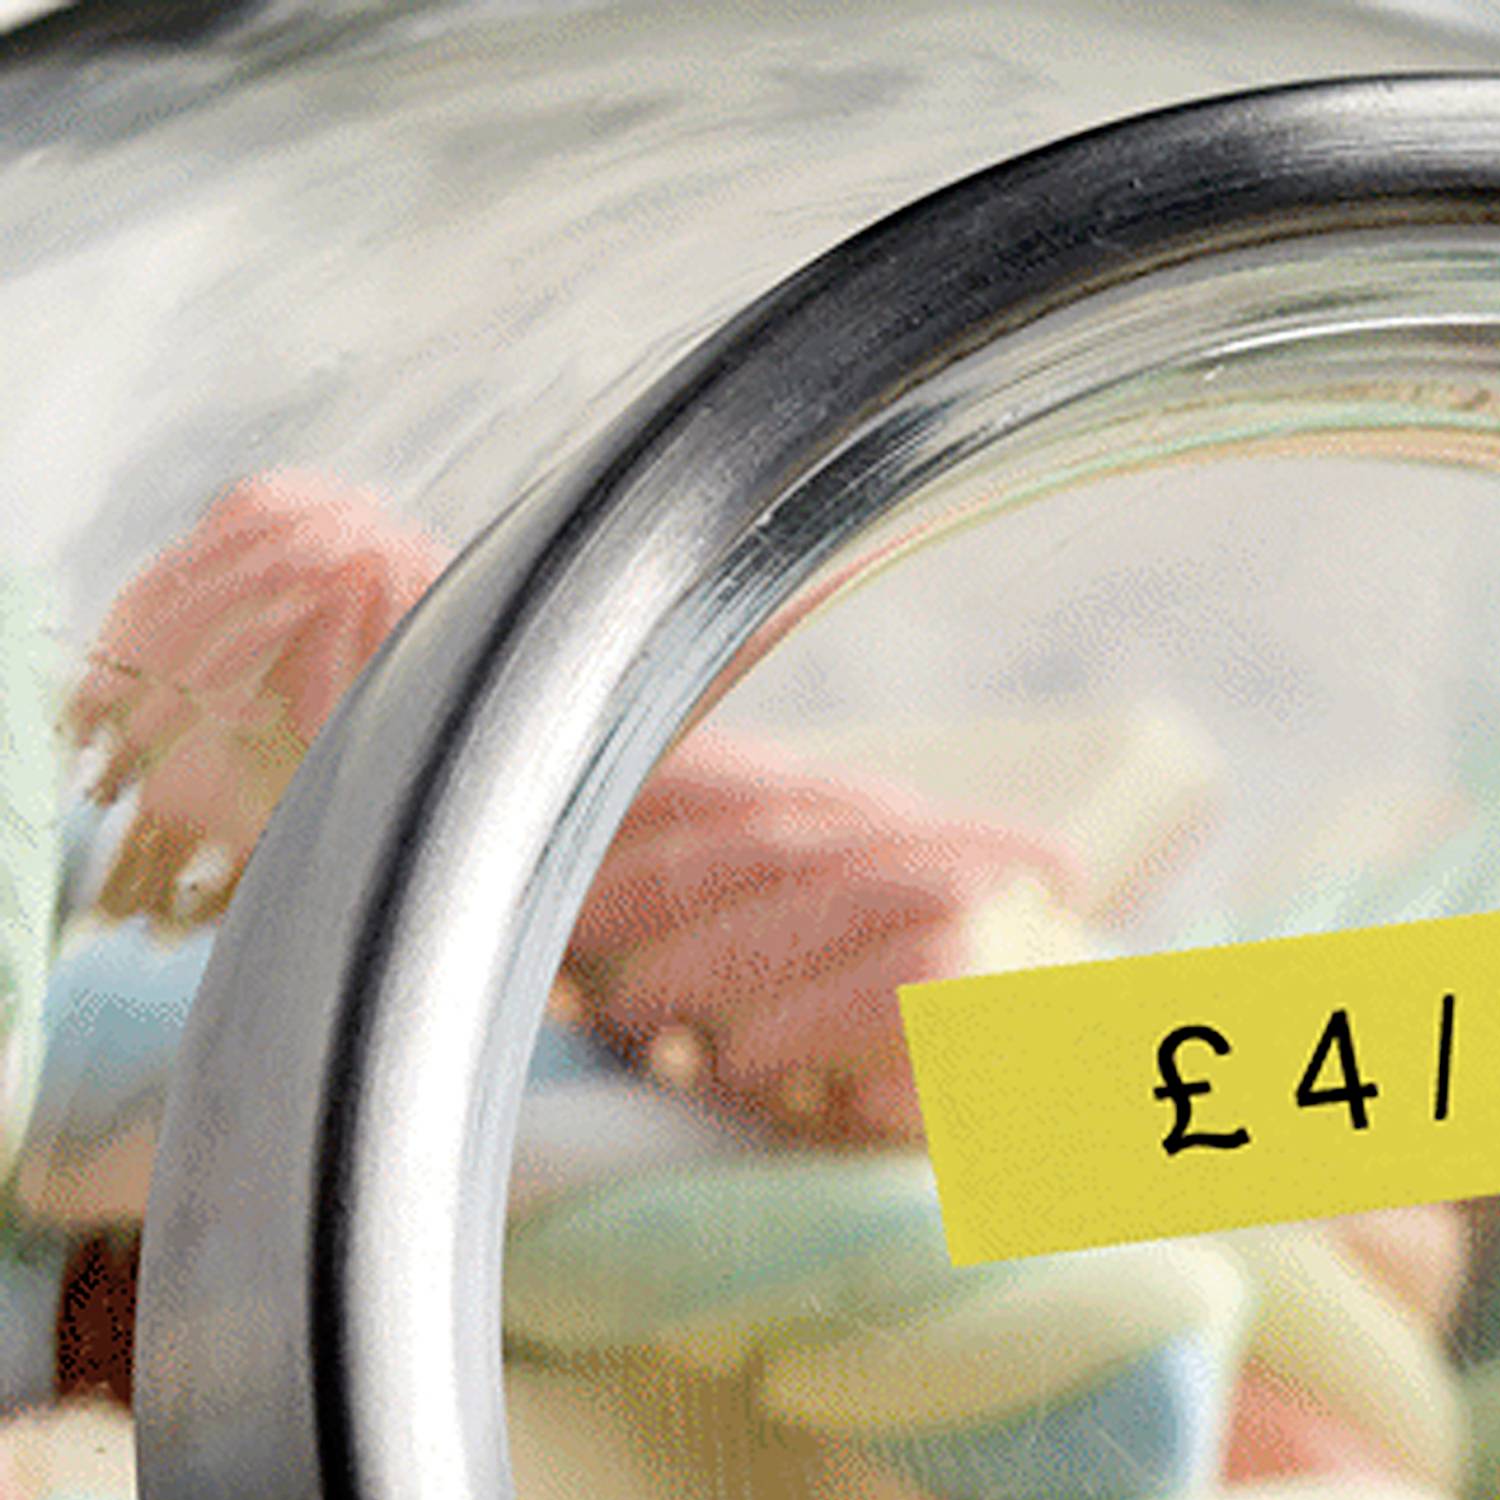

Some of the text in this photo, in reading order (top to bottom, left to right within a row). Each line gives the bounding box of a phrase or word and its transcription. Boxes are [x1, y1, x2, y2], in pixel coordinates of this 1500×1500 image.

[1152, 1024, 1251, 1157] £
[1294, 1008, 1380, 1131] 4
[1433, 993, 1456, 1122] /
